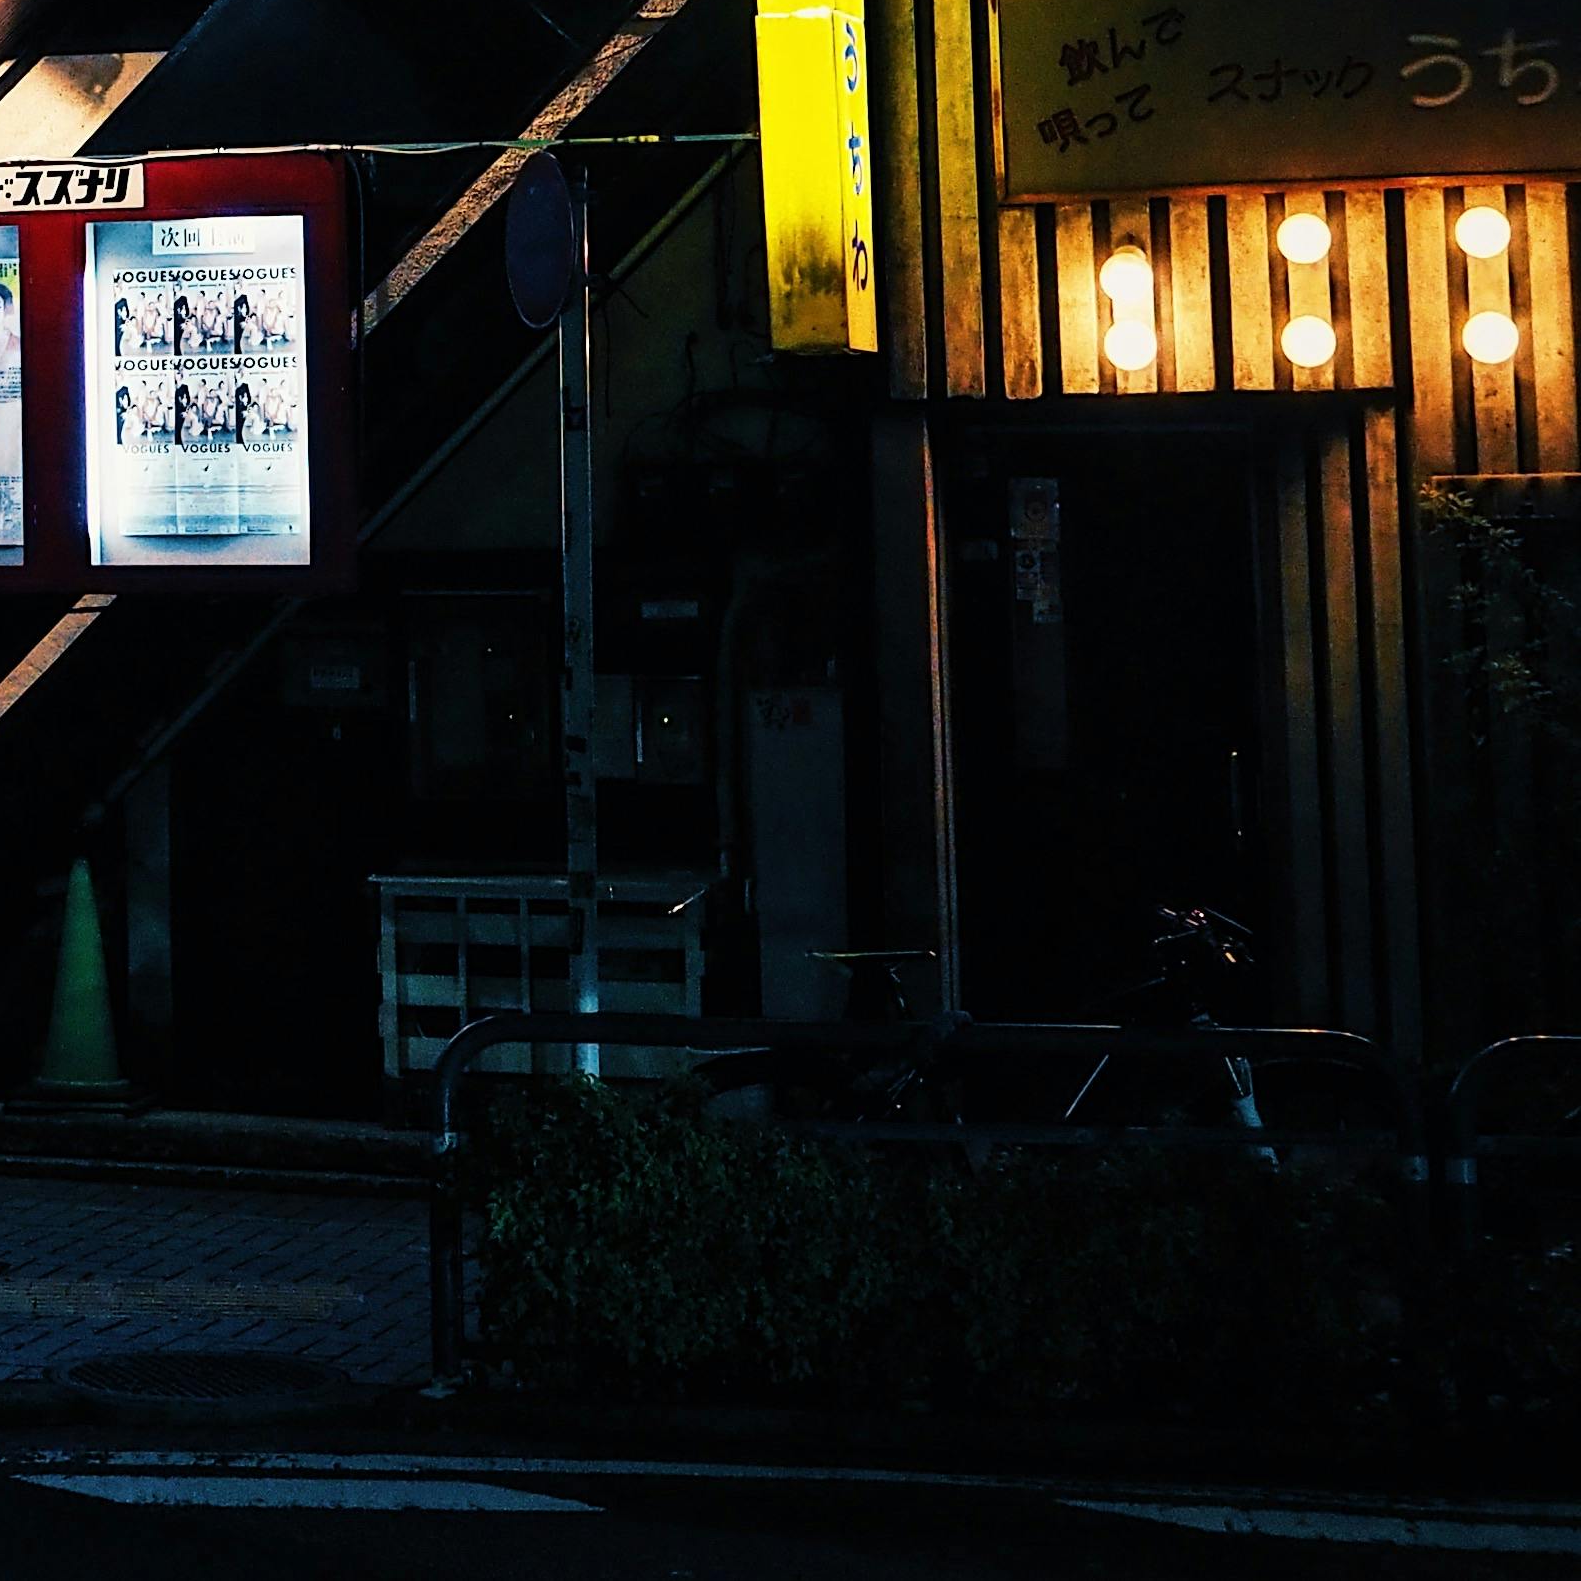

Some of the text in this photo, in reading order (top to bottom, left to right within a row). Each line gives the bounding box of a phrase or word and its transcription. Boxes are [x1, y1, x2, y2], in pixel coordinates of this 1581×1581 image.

[1058, 7, 1185, 86] 飲んで
[1207, 26, 1581, 110] スナック うち
[182, 443, 231, 453] VOGUES
[243, 443, 294, 453] VOGUES
